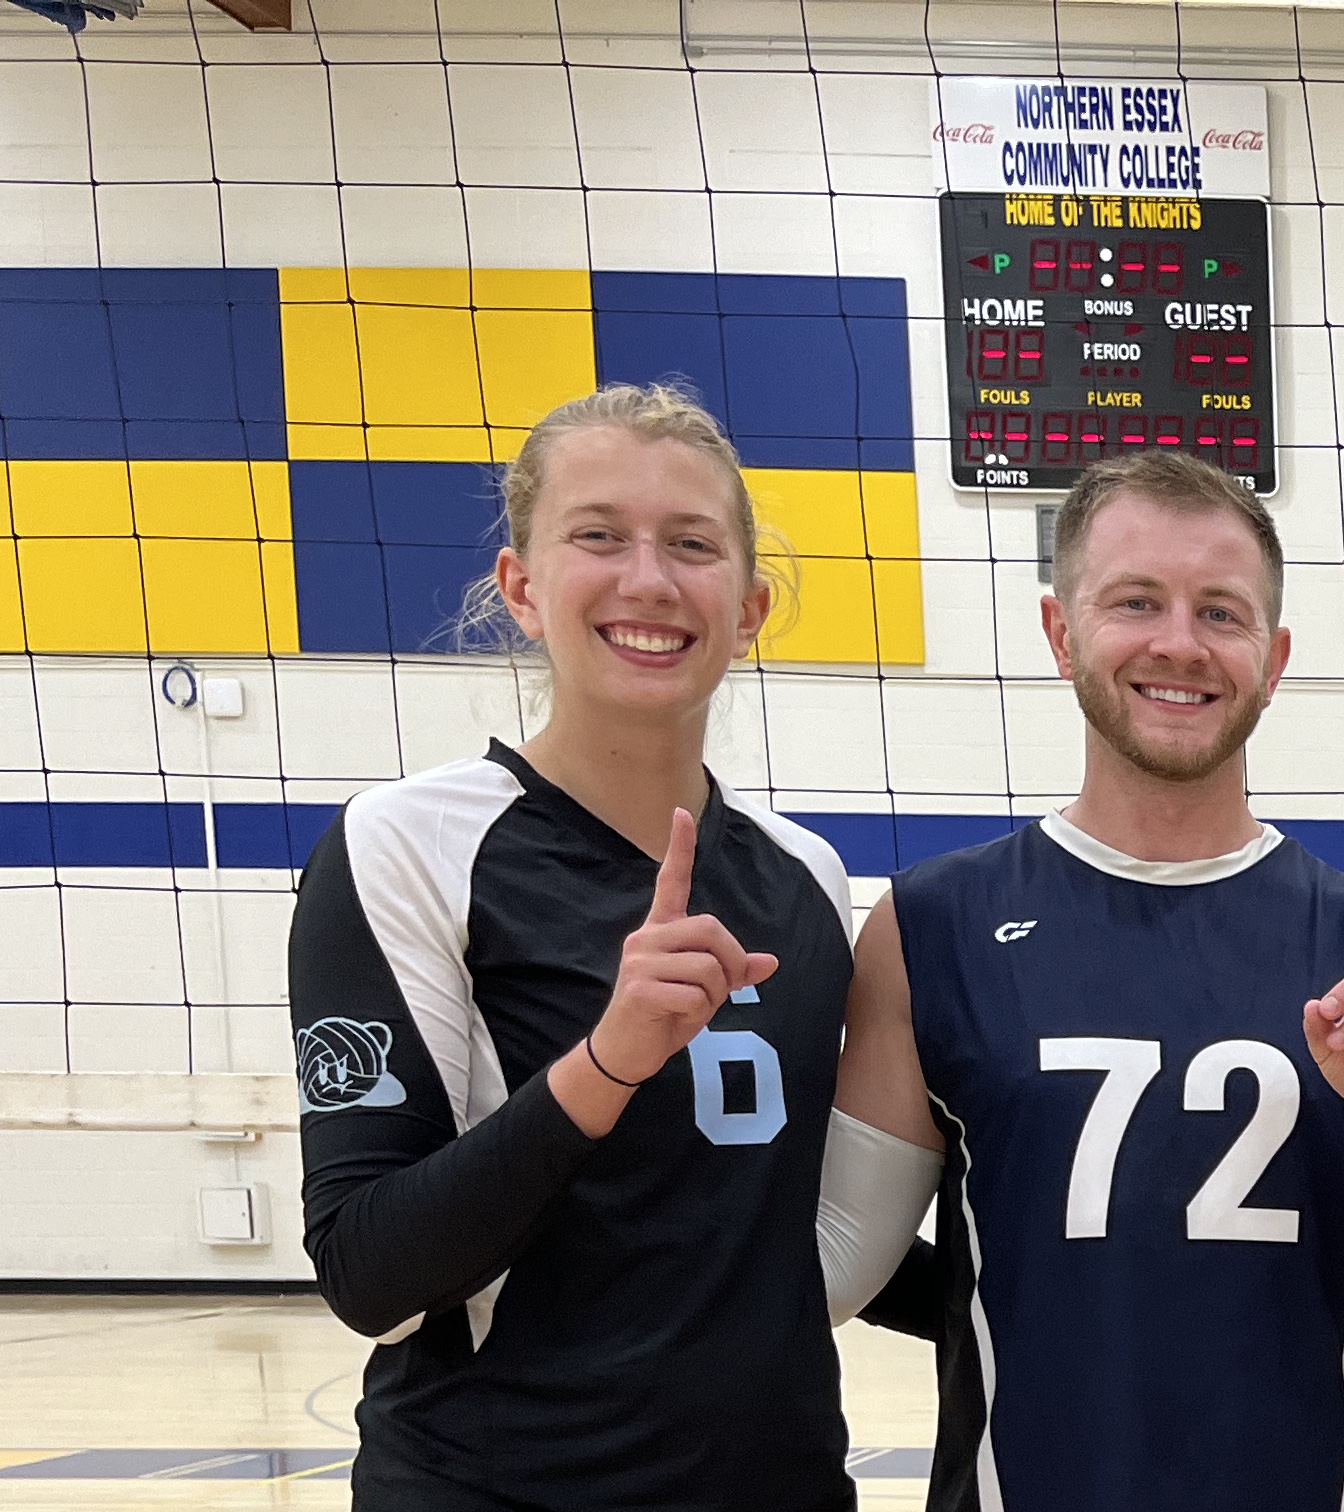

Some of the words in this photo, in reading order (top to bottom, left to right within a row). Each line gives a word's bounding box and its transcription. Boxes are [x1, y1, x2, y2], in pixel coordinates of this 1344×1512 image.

[1015, 85, 1113, 132] NORTHERN
[1123, 87, 1183, 133] ESSEX
[1002, 142, 1111, 188] COMMUNITY
[1119, 145, 1202, 190] COLLEGE
[1005, 193, 1056, 226] HOME
[1090, 195, 1123, 228] THE
[1127, 196, 1202, 230] KNIGHTS
[994, 253, 1011, 275] P
[1203, 258, 1219, 279] P
[962, 298, 1045, 327] HOME
[1084, 300, 1134, 316] BONUS
[1164, 302, 1253, 332] GUEST
[1083, 343, 1141, 361] PERIOD
[980, 389, 1030, 405] FOULS
[1087, 391, 1142, 408] PLAYER
[1202, 394, 1252, 410] FOULS
[976, 468, 1029, 486] POINTS
[687, 983, 788, 1146] 6
[1039, 1036, 1301, 1244] 72
